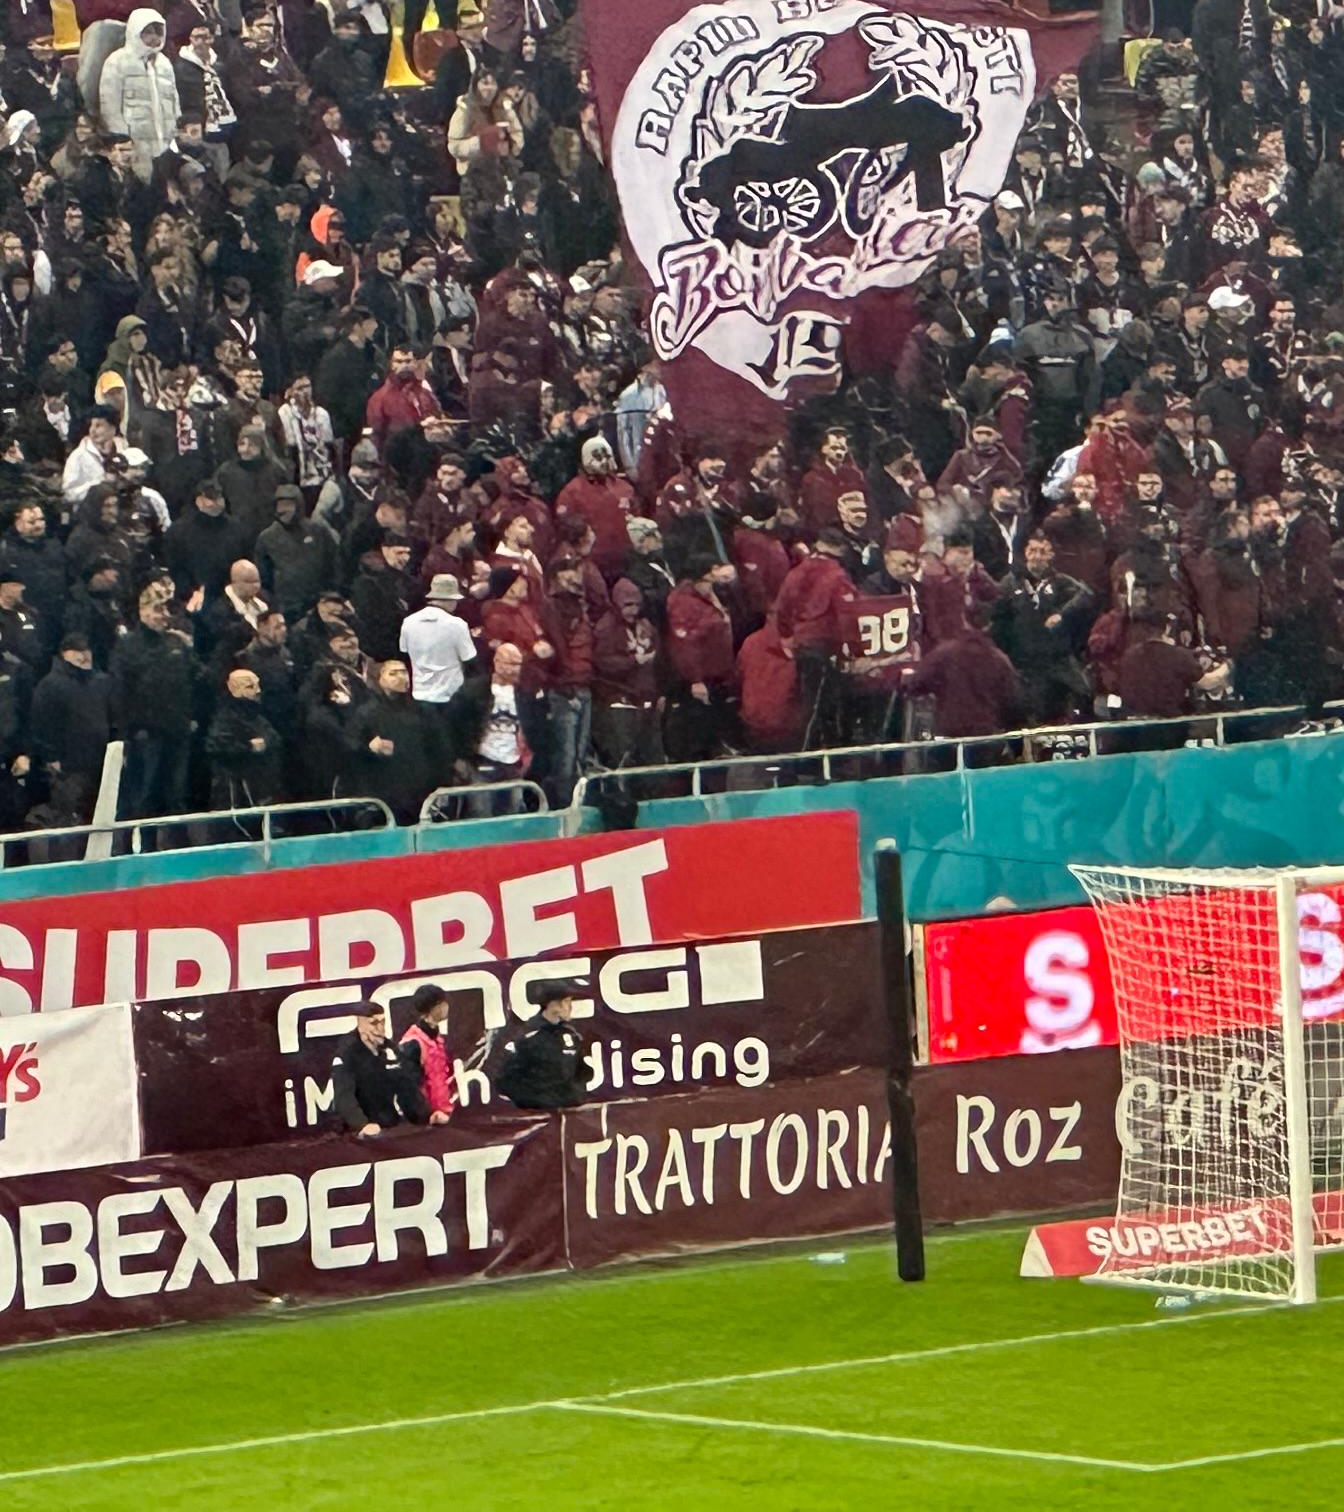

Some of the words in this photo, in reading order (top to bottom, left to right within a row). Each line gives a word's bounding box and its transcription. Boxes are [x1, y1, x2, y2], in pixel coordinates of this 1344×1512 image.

[1024, 932, 1093, 1030] S
[955, 1093, 1083, 1174] Roz
[1085, 1204, 1268, 1257] SUPERBET
